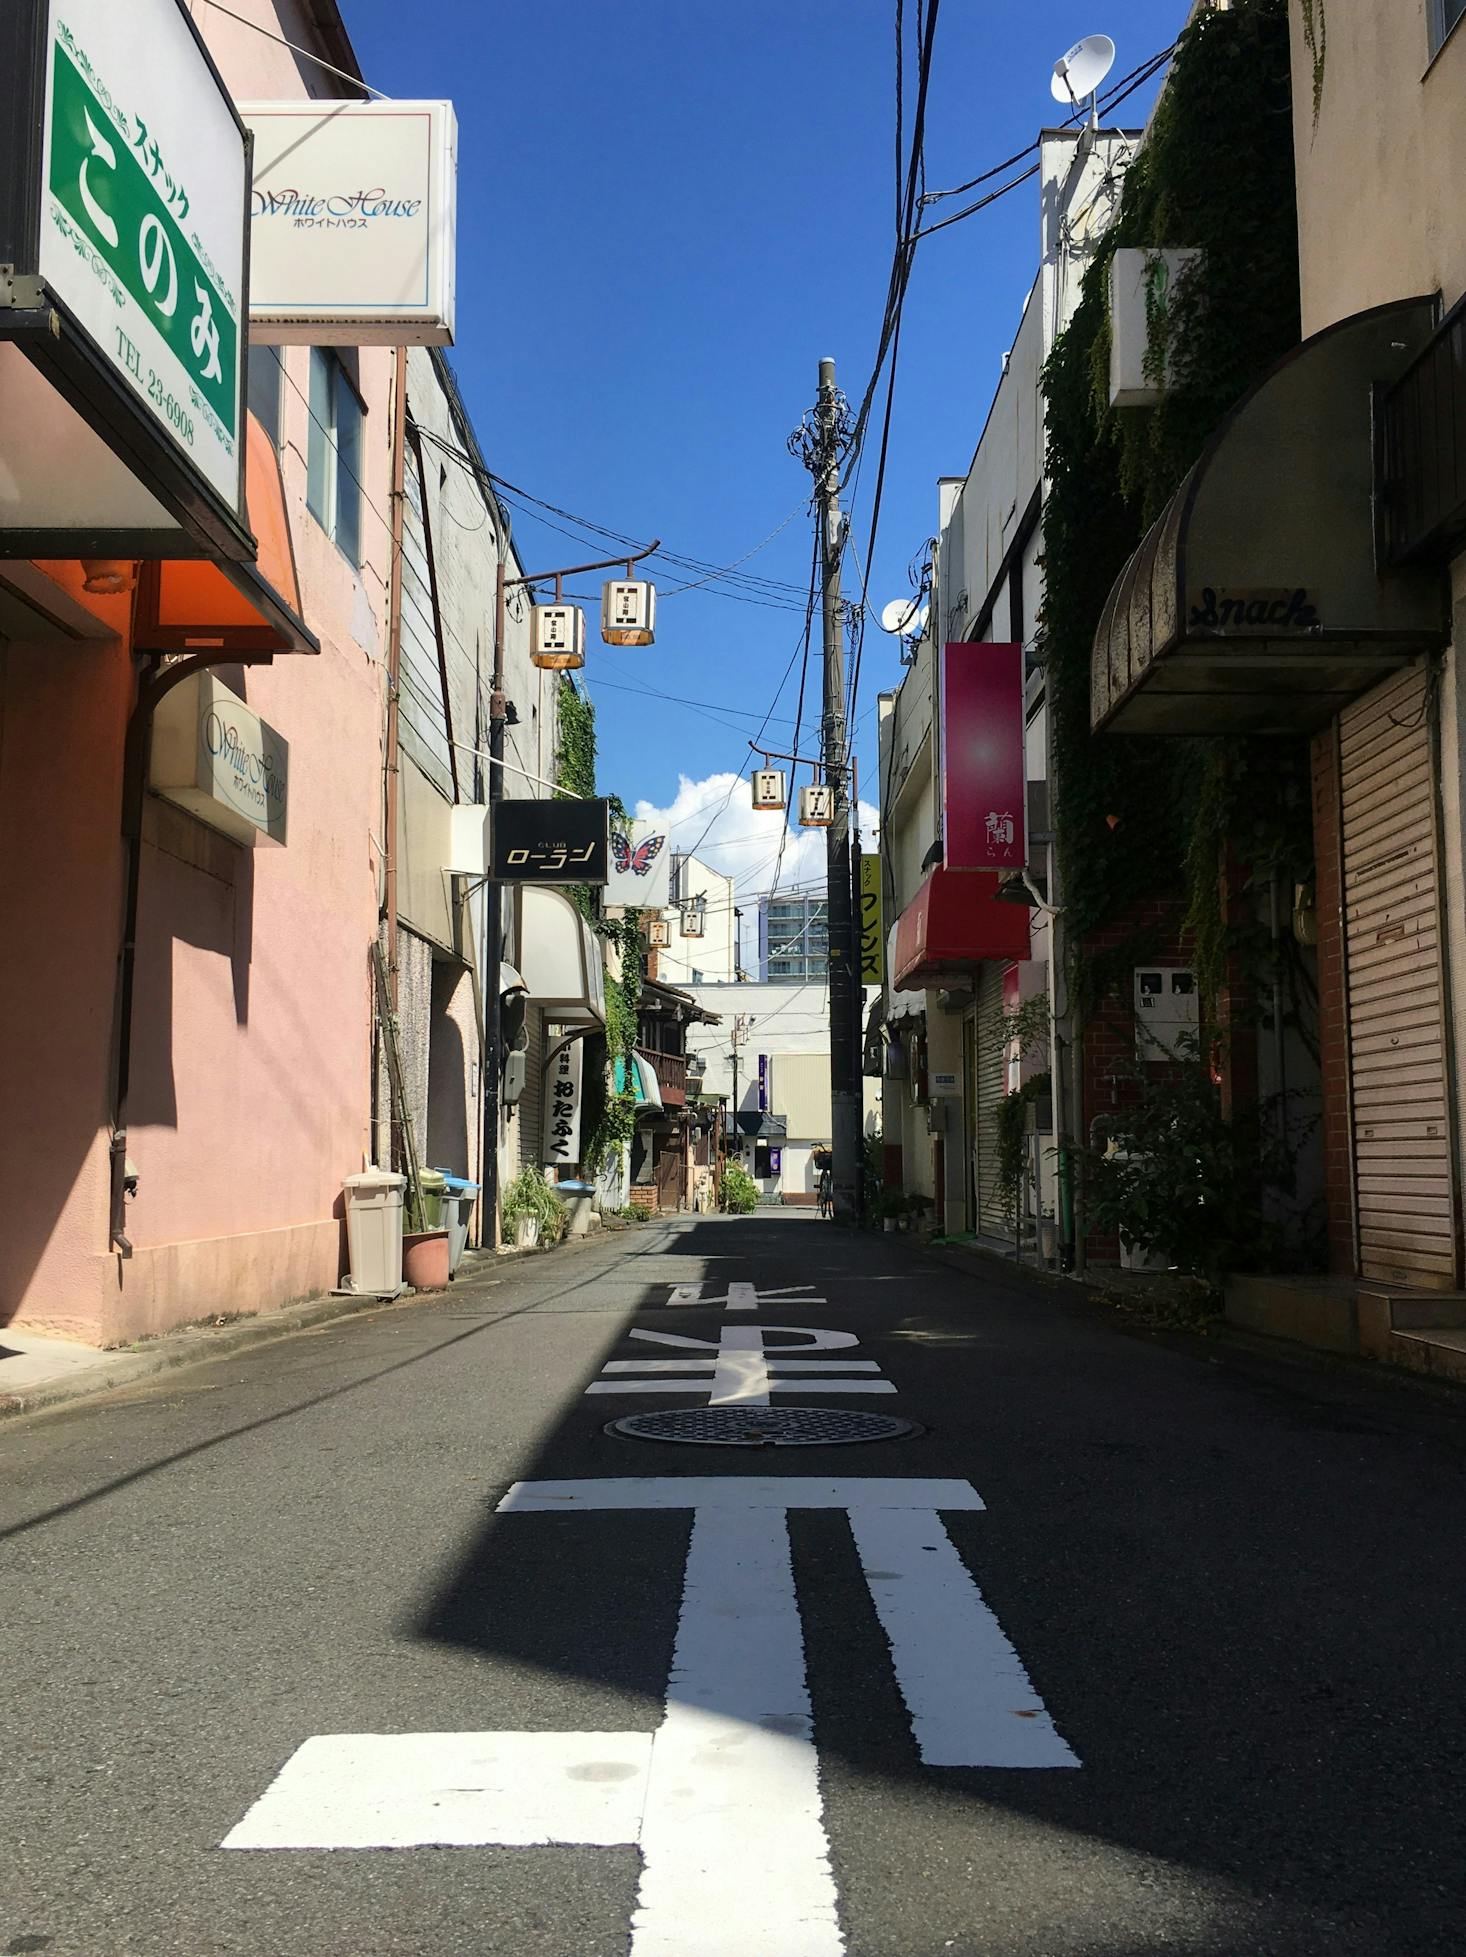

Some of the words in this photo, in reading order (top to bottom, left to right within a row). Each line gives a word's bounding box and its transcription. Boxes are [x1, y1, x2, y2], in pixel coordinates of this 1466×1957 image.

[133, 112, 190, 221] スナック
[251, 188, 326, 218] White
[327, 187, 422, 218] House
[293, 217, 369, 229] ホワイトハウス
[78, 104, 223, 385] このみ
[115, 325, 144, 385] TEL
[147, 367, 195, 447] 23-6908
[1190, 585, 1321, 625] Snack
[205, 711, 250, 776] White
[232, 775, 266, 808] ホワイトハウス
[983, 810, 1014, 844] 蘭
[506, 841, 596, 870] ローラン
[986, 846, 1013, 857] らん
[863, 859, 873, 887] スナック
[549, 1079, 575, 1157] おたふく
